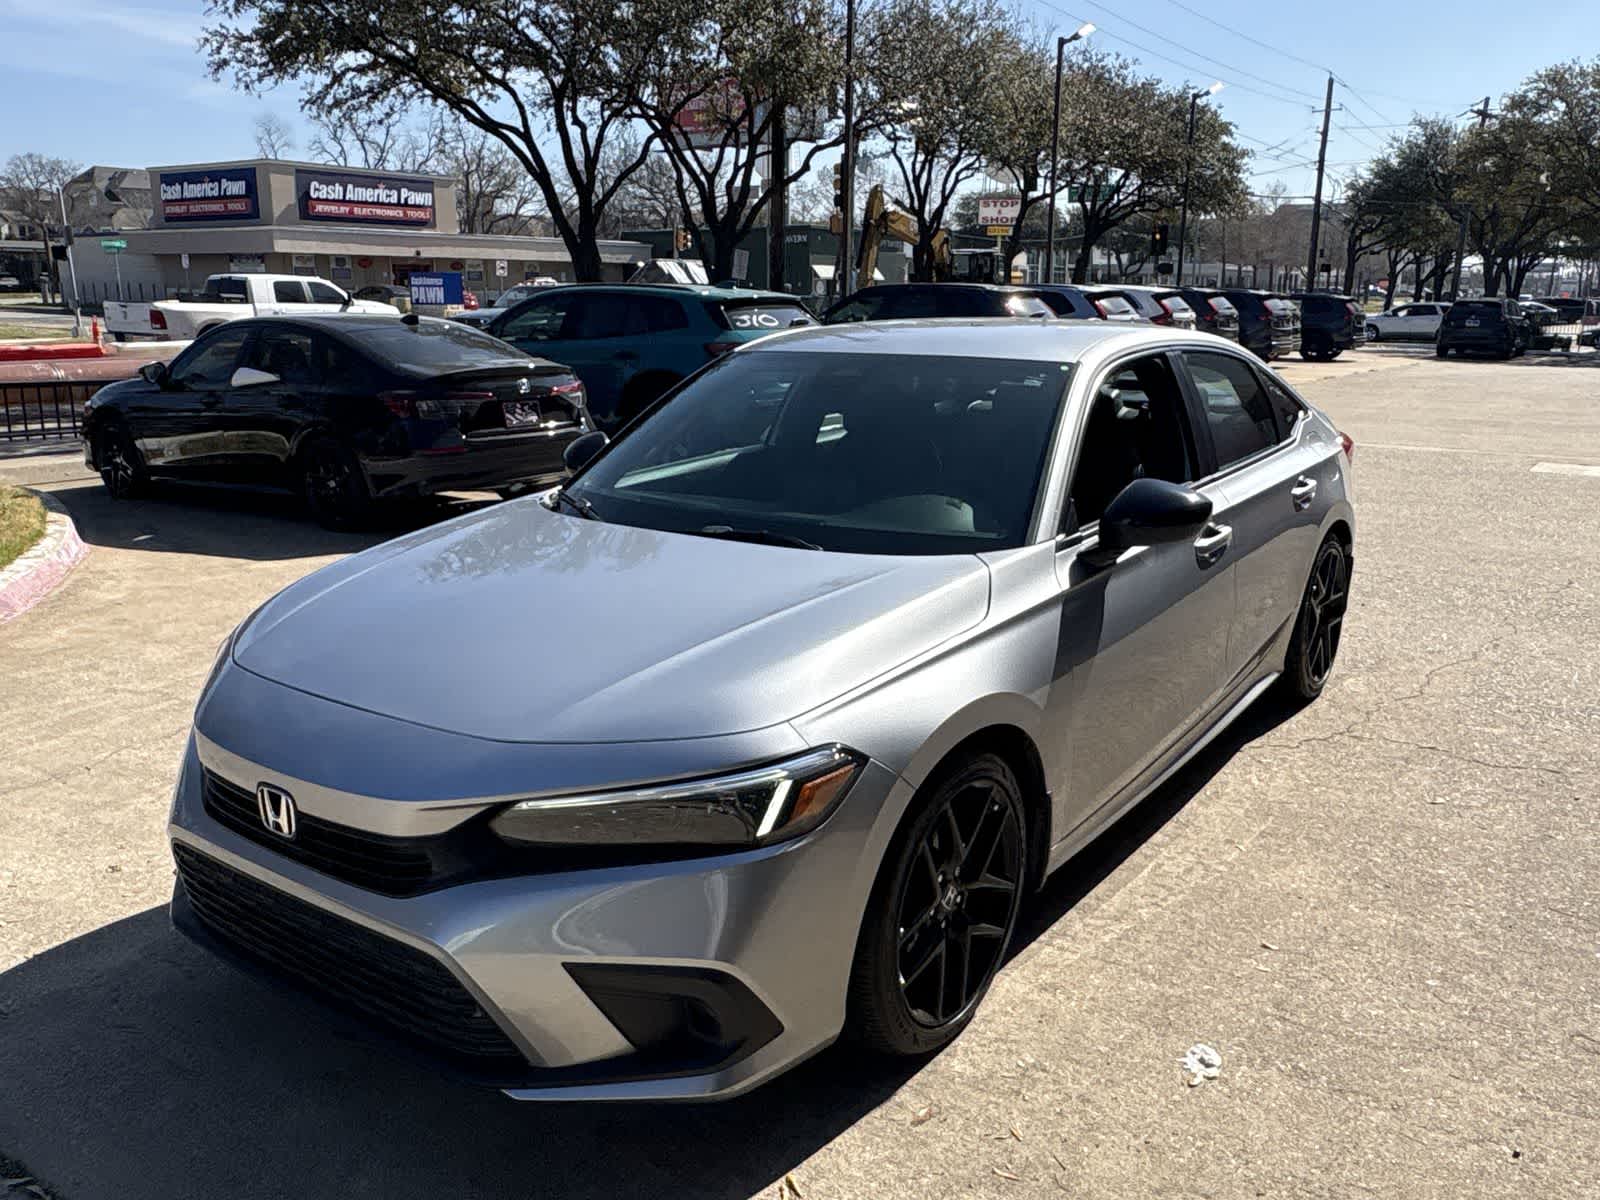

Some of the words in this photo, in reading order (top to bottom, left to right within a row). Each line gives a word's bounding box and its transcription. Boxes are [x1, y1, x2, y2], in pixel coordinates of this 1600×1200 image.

[161, 183, 181, 200] Cash
[183, 181, 218, 198] America
[221, 179, 246, 195] Pawn
[310, 181, 343, 199] Cash
[346, 184, 398, 203] America
[401, 188, 432, 206] Pawn
[314, 204, 349, 214] JEWELRY
[353, 206, 404, 217] ELECTRONICS
[407, 210, 430, 219] TOOLS
[982, 200, 1019, 208] STOP
[411, 286, 445, 304] PAWN
